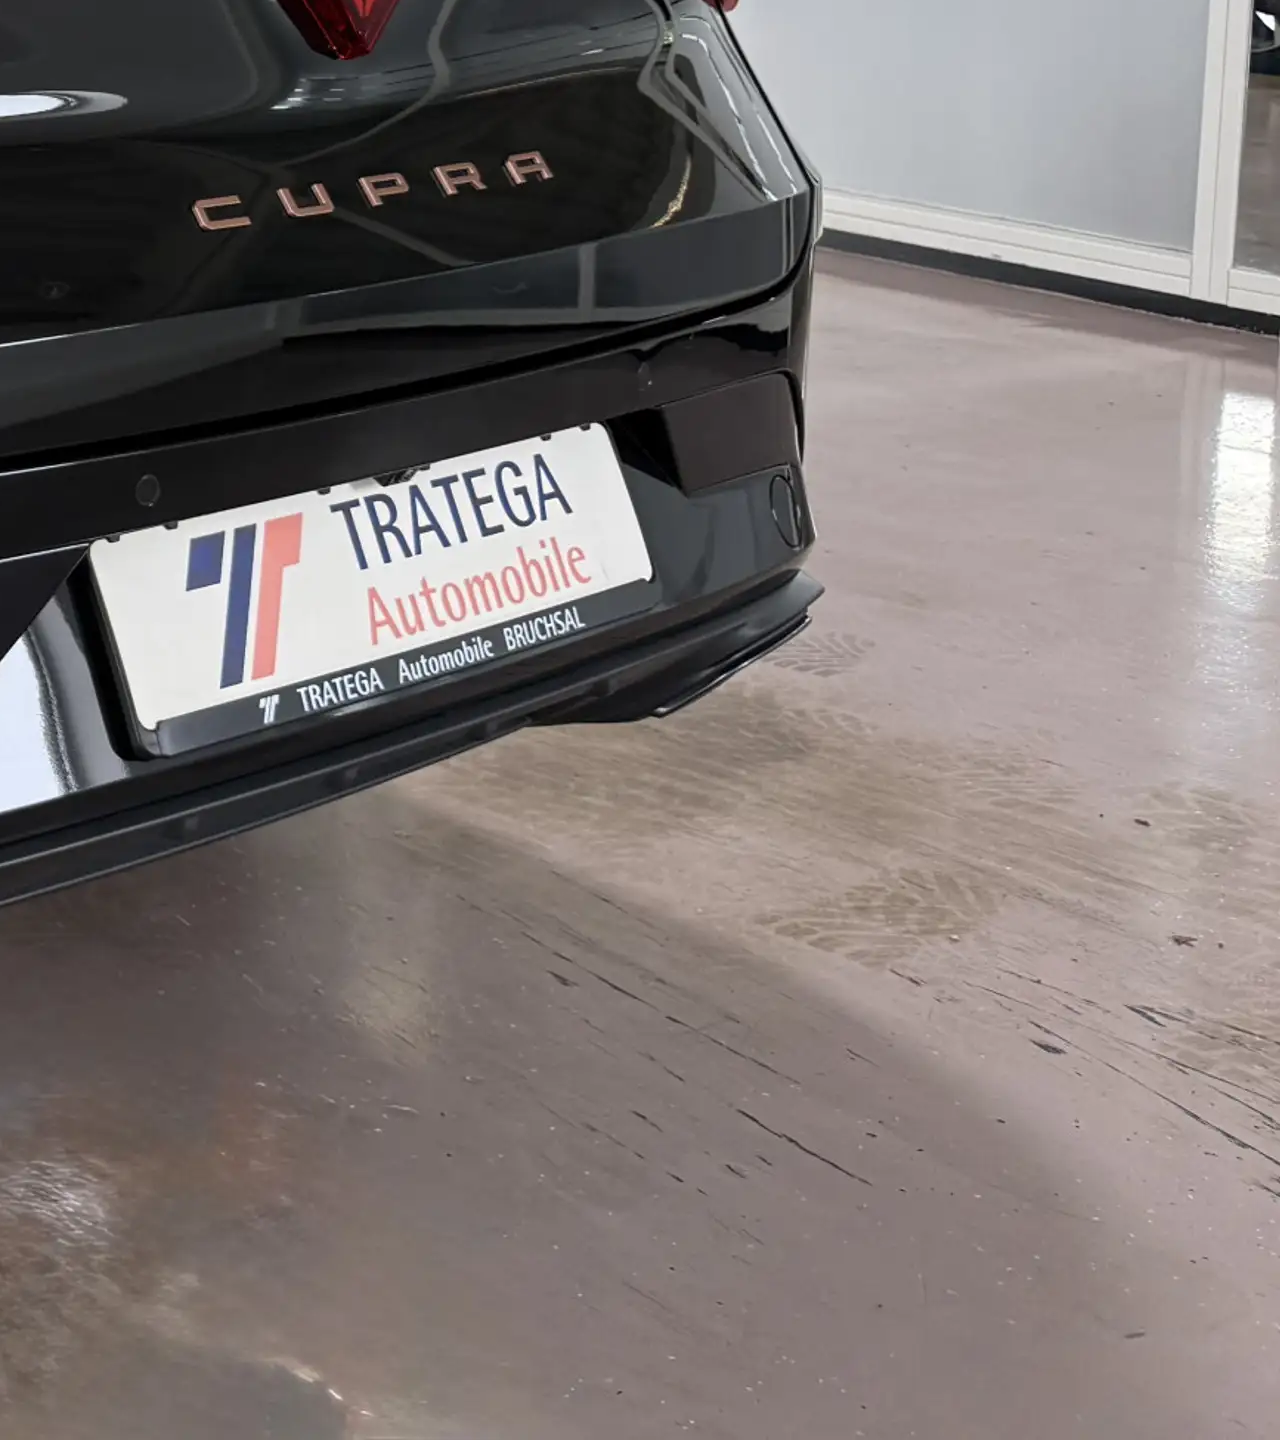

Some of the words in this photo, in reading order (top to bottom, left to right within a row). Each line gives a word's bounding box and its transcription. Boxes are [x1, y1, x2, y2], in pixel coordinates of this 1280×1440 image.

[191, 150, 554, 231] CUPRA
[328, 452, 574, 571] TRATEGA
[366, 536, 592, 646] Automobile
[296, 666, 385, 712] TRATEGA
[397, 635, 494, 685] Automobile
[502, 605, 586, 651] BRUCHSAL
